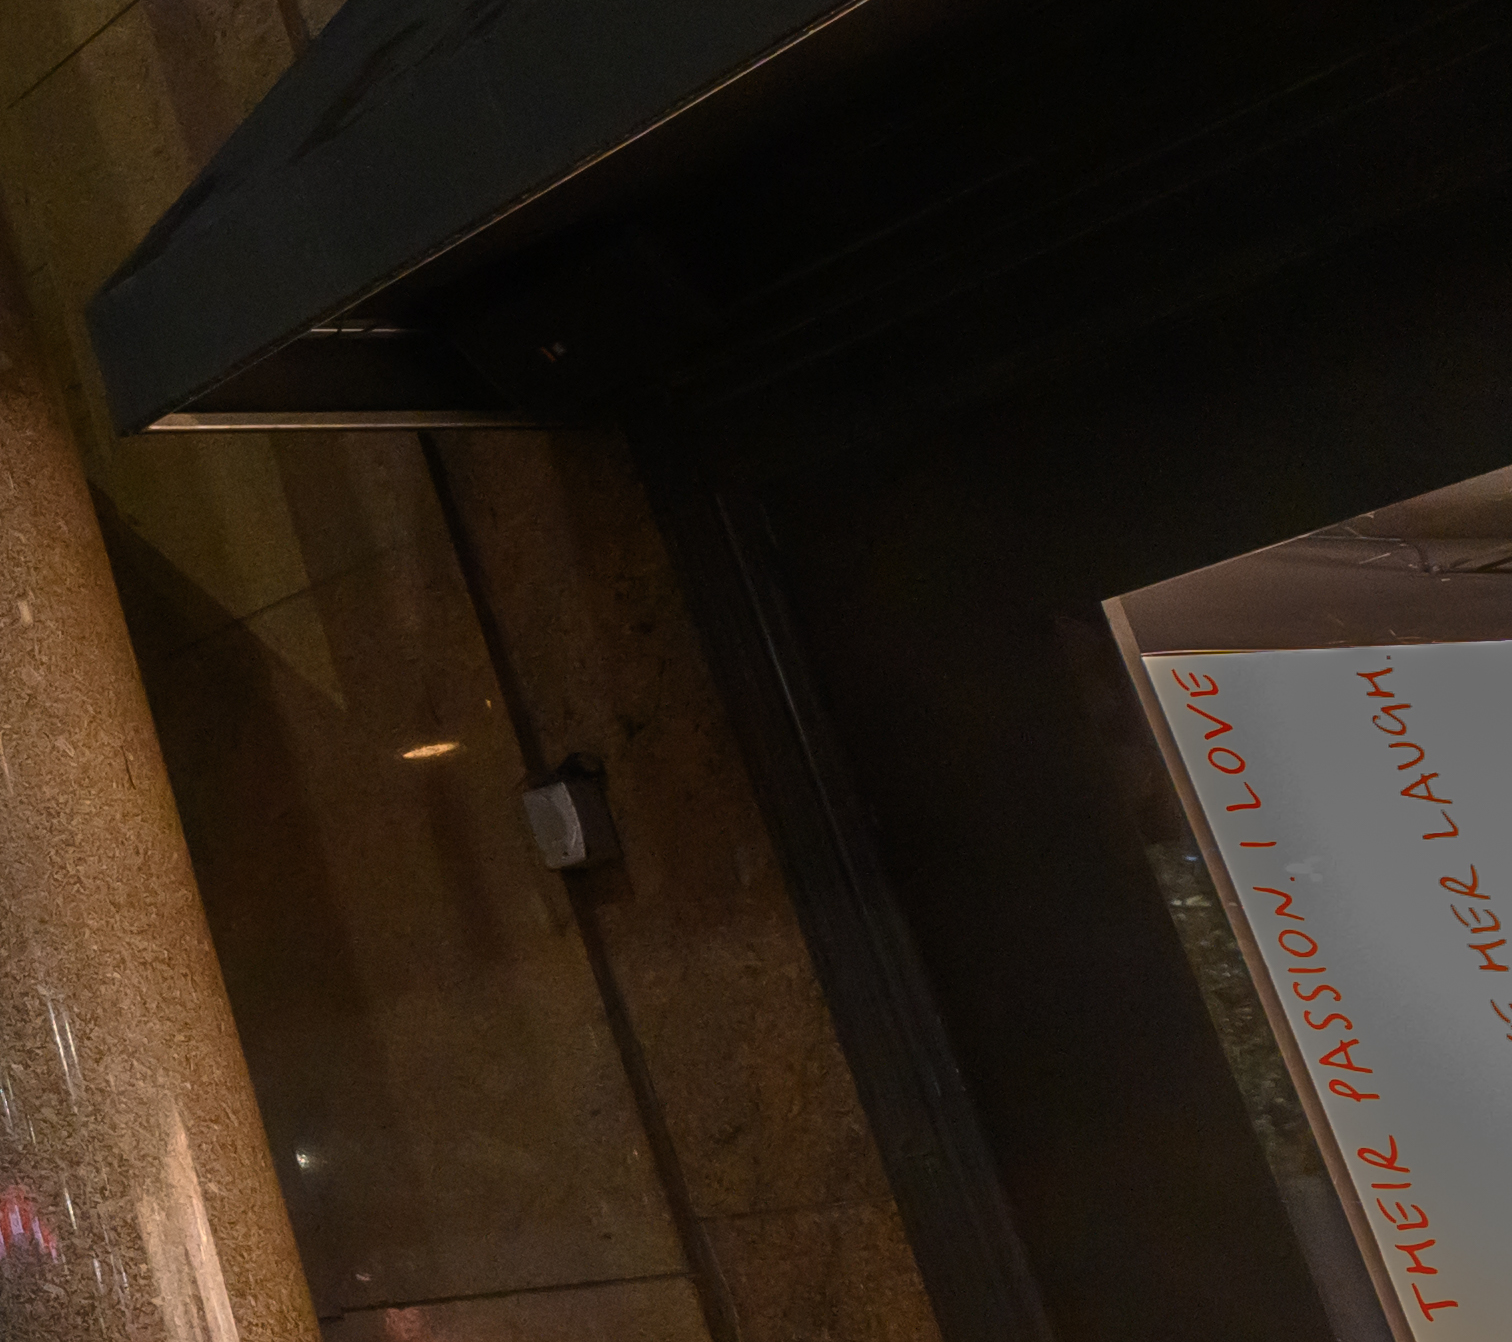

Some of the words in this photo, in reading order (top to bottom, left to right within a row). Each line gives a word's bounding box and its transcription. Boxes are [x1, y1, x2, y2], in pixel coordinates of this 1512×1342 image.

[1170, 668, 1262, 812] LOVE
[1355, 655, 1460, 841] LAUGH.
[1252, 876, 1381, 1102] PASSION.
[1439, 864, 1510, 972] HER
[1356, 1134, 1459, 1323] THEIR
